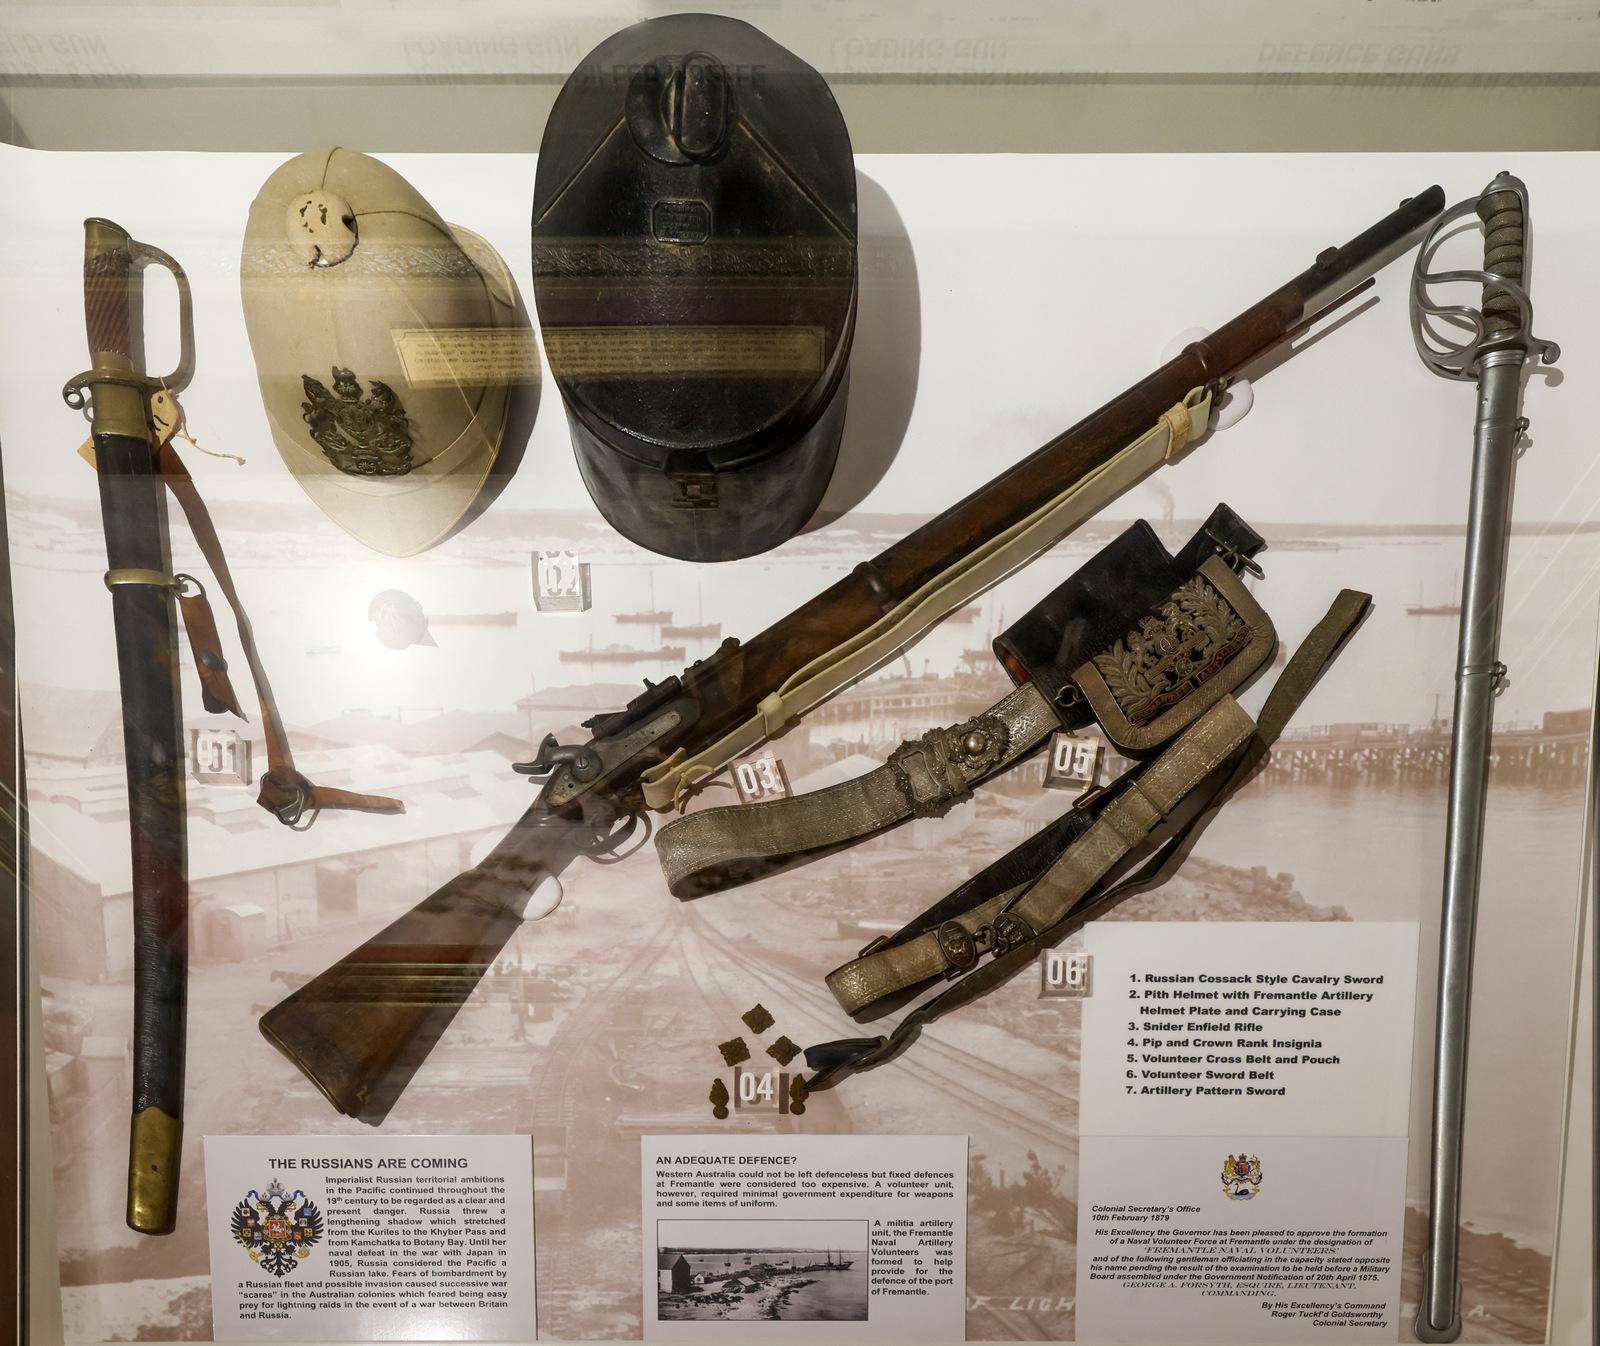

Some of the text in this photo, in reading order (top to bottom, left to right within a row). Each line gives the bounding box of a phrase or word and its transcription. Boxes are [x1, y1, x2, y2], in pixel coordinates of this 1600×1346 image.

[1055, 741, 1090, 774] 05
[738, 758, 775, 794] 03
[1048, 957, 1081, 985] 06
[1130, 974, 1384, 986] 1. Russian Cossack Style Cavalry Sword
[1129, 990, 1373, 1002] 2. Pith Helmet with Fremantle Artillery
[1140, 1006, 1341, 1018] Helmet Plate and Carrying Case
[1128, 1022, 1263, 1032] 3. Snider Enfield Rifle
[1127, 1038, 1322, 1050] 4. Pip and Crown Rank Insignia
[1127, 1054, 1340, 1064] 5. Volunteer Cross Belt and Pouch
[1126, 1069, 1275, 1080] 6. Volunteer Sword Belt
[740, 1072, 774, 1101] 04
[1126, 1086, 1285, 1097] 7. Artillery Pattern Sword
[268, 1158, 468, 1169] THE RUSSIANS ARE COMING
[656, 1156, 797, 1165] AN ADEQUATE DEFENCE?
[656, 1170, 693, 1178] Western
[696, 1170, 736, 1178] Australia
[738, 1170, 763, 1178] could
[784, 1170, 795, 1178] be
[798, 1170, 813, 1178] left
[815, 1171, 869, 1179] defenceless
[871, 1171, 887, 1179] but
[888, 1171, 911, 1179] fixed
[914, 1171, 954, 1179] defences
[325, 1176, 373, 1185] Imperialist
[670, 1180, 715, 1188] Fremantle
[746, 1180, 796, 1188] considered
[821, 1181, 869, 1189] expensive.
[934, 1181, 954, 1189] unit,
[656, 1190, 697, 1198] however,
[701, 1190, 738, 1199] required
[782, 1191, 836, 1199] government
[840, 1190, 893, 1199] expenditure
[897, 1190, 910, 1199] for
[914, 1191, 954, 1199] weapons
[1176, 1205, 1201, 1213] Office
[874, 1219, 954, 1228] A militia artillery
[1111, 1214, 1149, 1223] February
[1150, 1214, 1170, 1222] 1879
[871, 1229, 891, 1238] unit,
[909, 1229, 953, 1237] Fremantle
[918, 1238, 953, 1248] Artillery
[871, 1248, 919, 1256] Volunteers
[871, 1257, 903, 1265] formed
[934, 1258, 953, 1267] help
[871, 1268, 905, 1276] provide
[245, 1280, 282, 1289] Russian
[284, 1280, 304, 1288] fleet
[306, 1280, 323, 1288] and
[325, 1280, 363, 1290] possible
[365, 1280, 403, 1288] invasion
[405, 1280, 437, 1288] caused
[871, 1277, 907, 1285] defence
[918, 1277, 933, 1285] the
[934, 1278, 953, 1286] port
[871, 1287, 929, 1295] of Fremantle.
[1261, 1302, 1273, 1310] By
[1344, 1302, 1387, 1310] Command
[1271, 1310, 1297, 1319] Roger
[1330, 1311, 1383, 1320] Goldsworthy
[1312, 1319, 1388, 1329] Colonial Secretary
